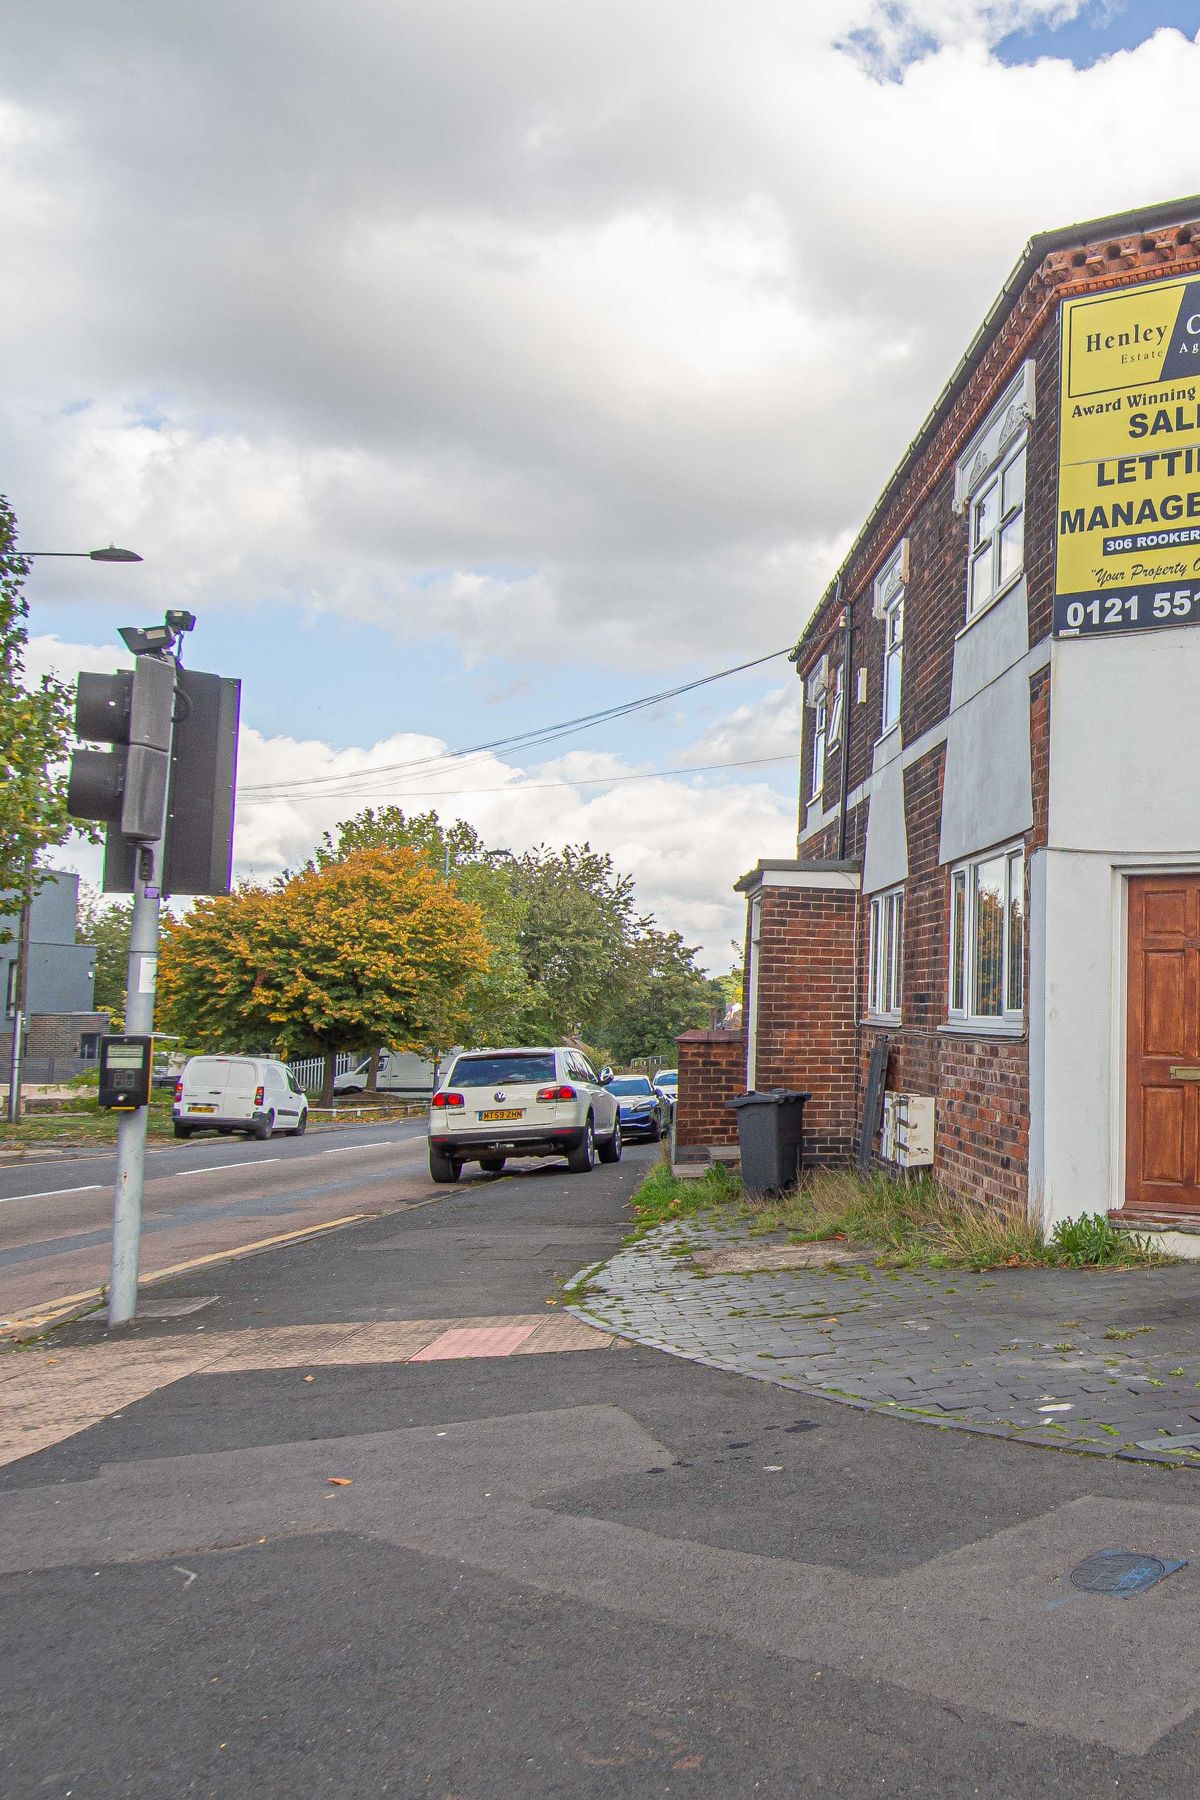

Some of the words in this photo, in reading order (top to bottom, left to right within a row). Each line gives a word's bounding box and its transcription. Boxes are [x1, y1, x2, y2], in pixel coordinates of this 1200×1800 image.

[1086, 324, 1168, 352] Henley
[1121, 350, 1163, 364] Estate
[1072, 397, 1121, 418] Award
[1126, 386, 1196, 409] Winning
[1106, 538, 1132, 552] 306
[1130, 561, 1188, 579] Property
[1066, 595, 1138, 627] 0121
